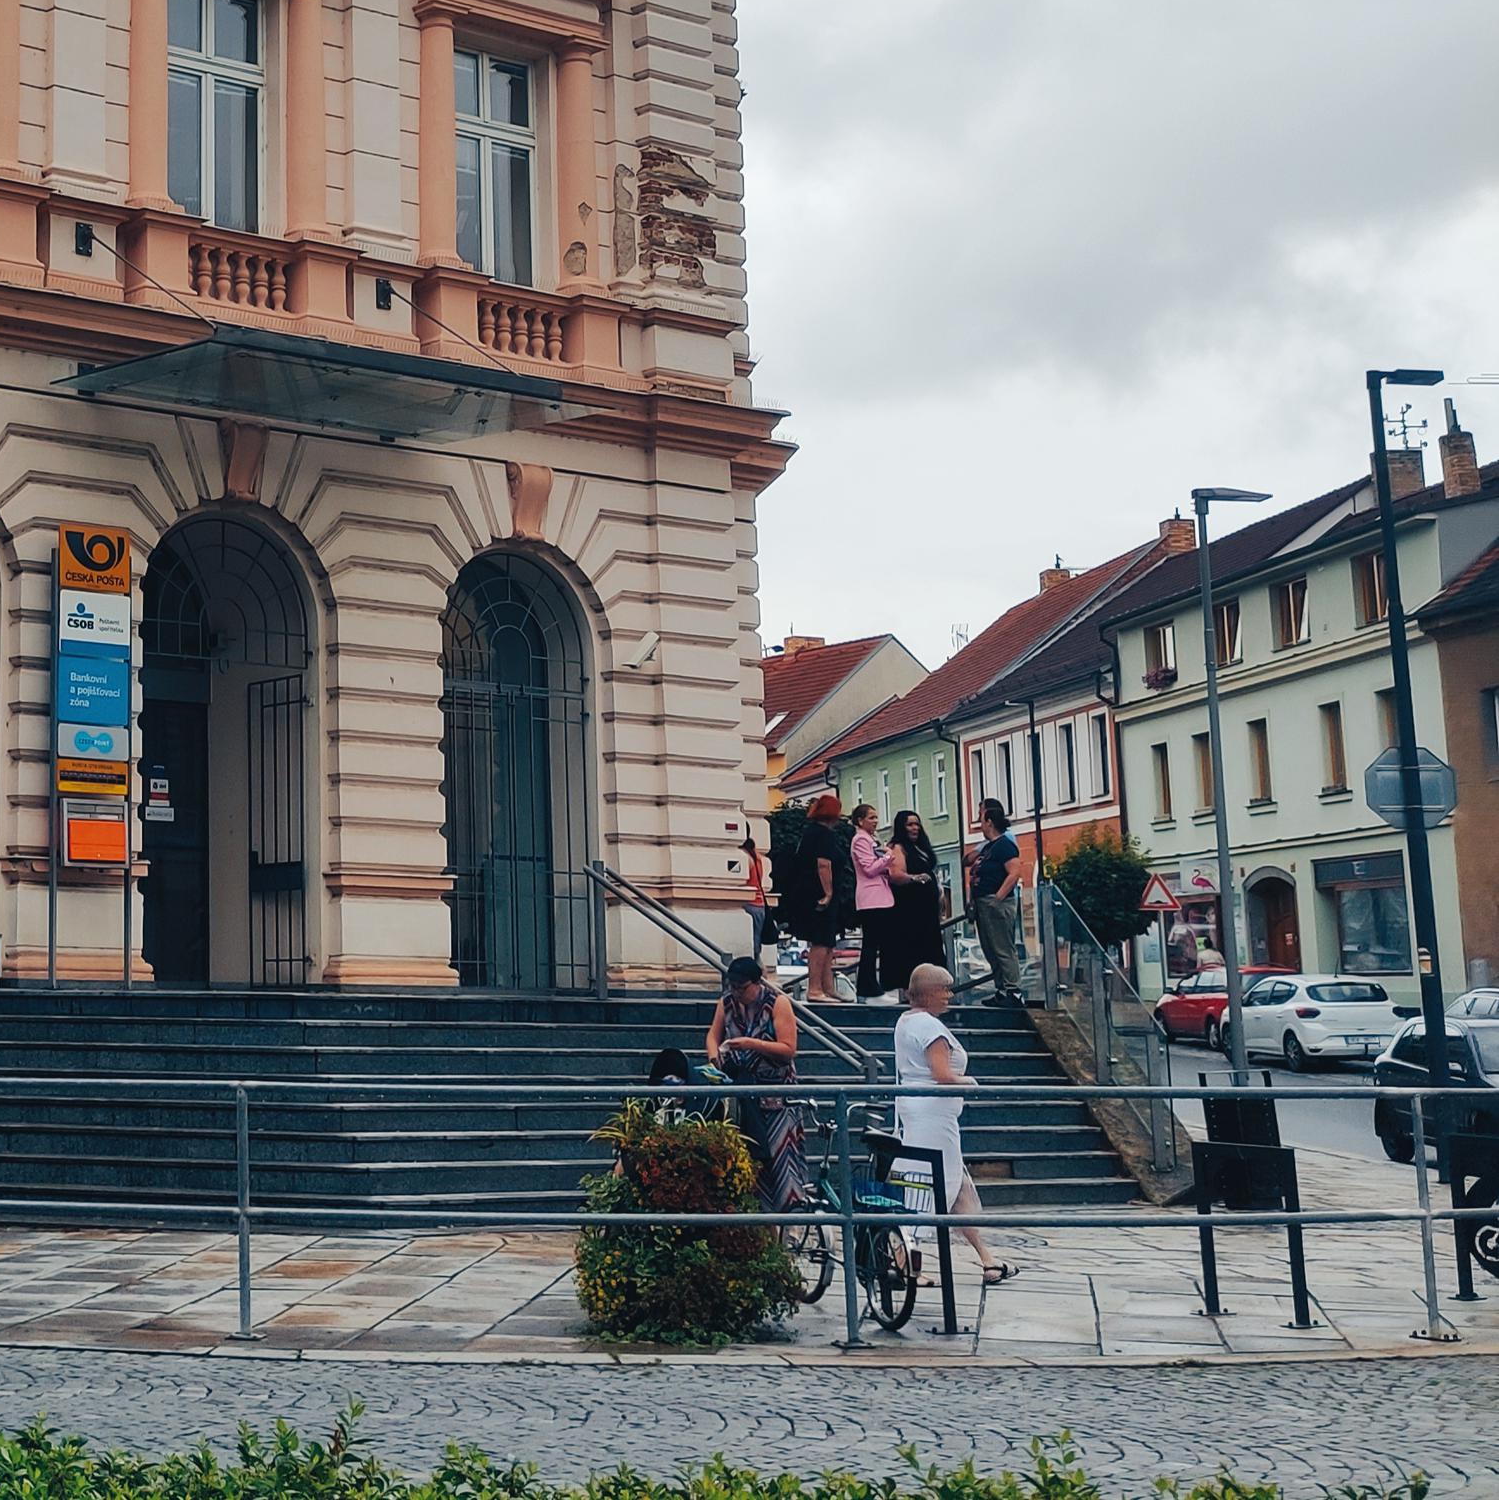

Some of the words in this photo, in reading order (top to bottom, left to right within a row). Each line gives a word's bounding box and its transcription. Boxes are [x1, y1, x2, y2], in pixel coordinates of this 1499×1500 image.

[65, 570, 94, 583] ČESKÁ
[97, 575, 125, 587] POŠTA
[67, 618, 94, 630] ČSOB
[70, 672, 108, 684] Bankovní
[70, 686, 76, 694] a
[70, 697, 90, 707] zóna
